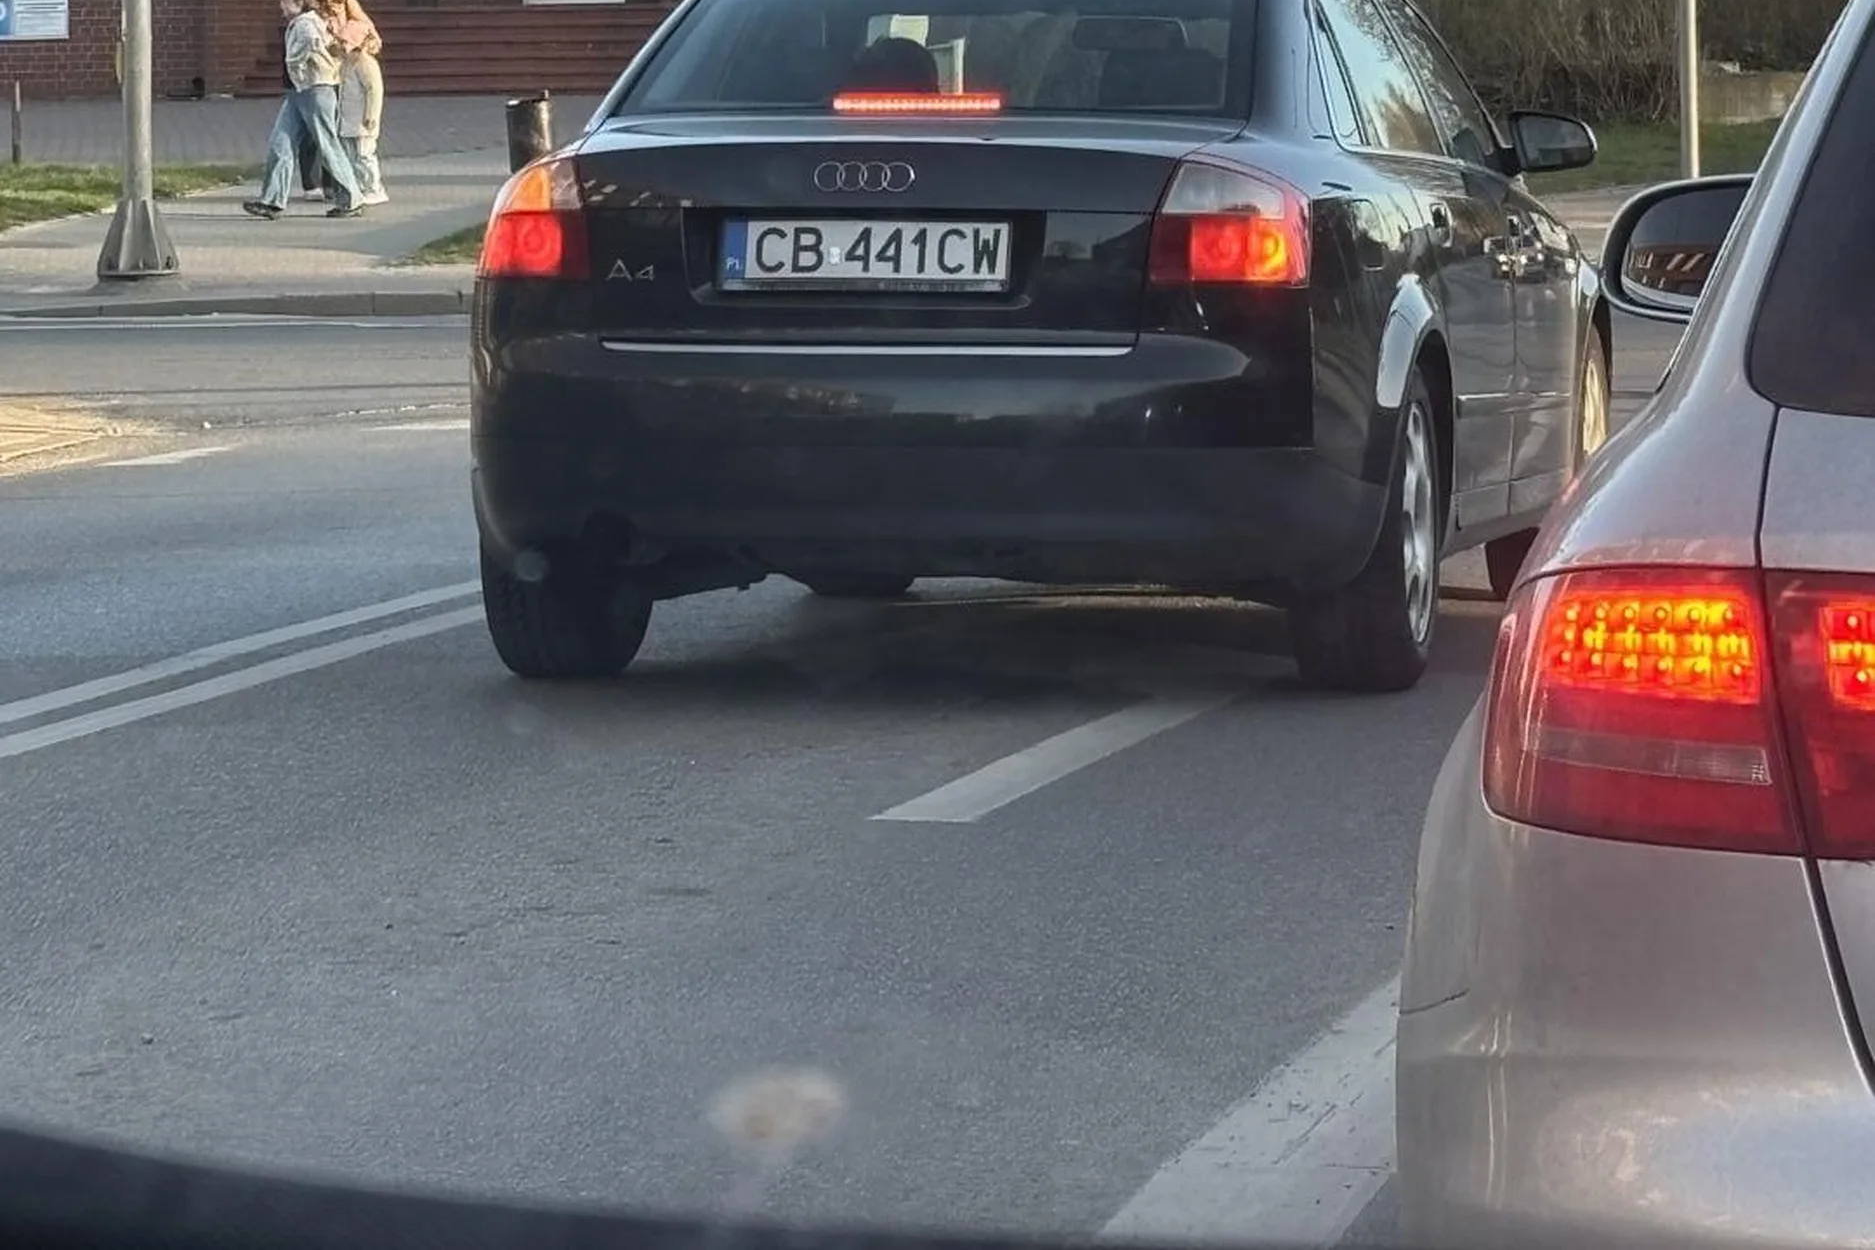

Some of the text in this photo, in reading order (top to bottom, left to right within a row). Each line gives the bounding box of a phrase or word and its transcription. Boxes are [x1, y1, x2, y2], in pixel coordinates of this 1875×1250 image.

[755, 227, 1001, 275] CB 441CW
[605, 258, 655, 281] A4
